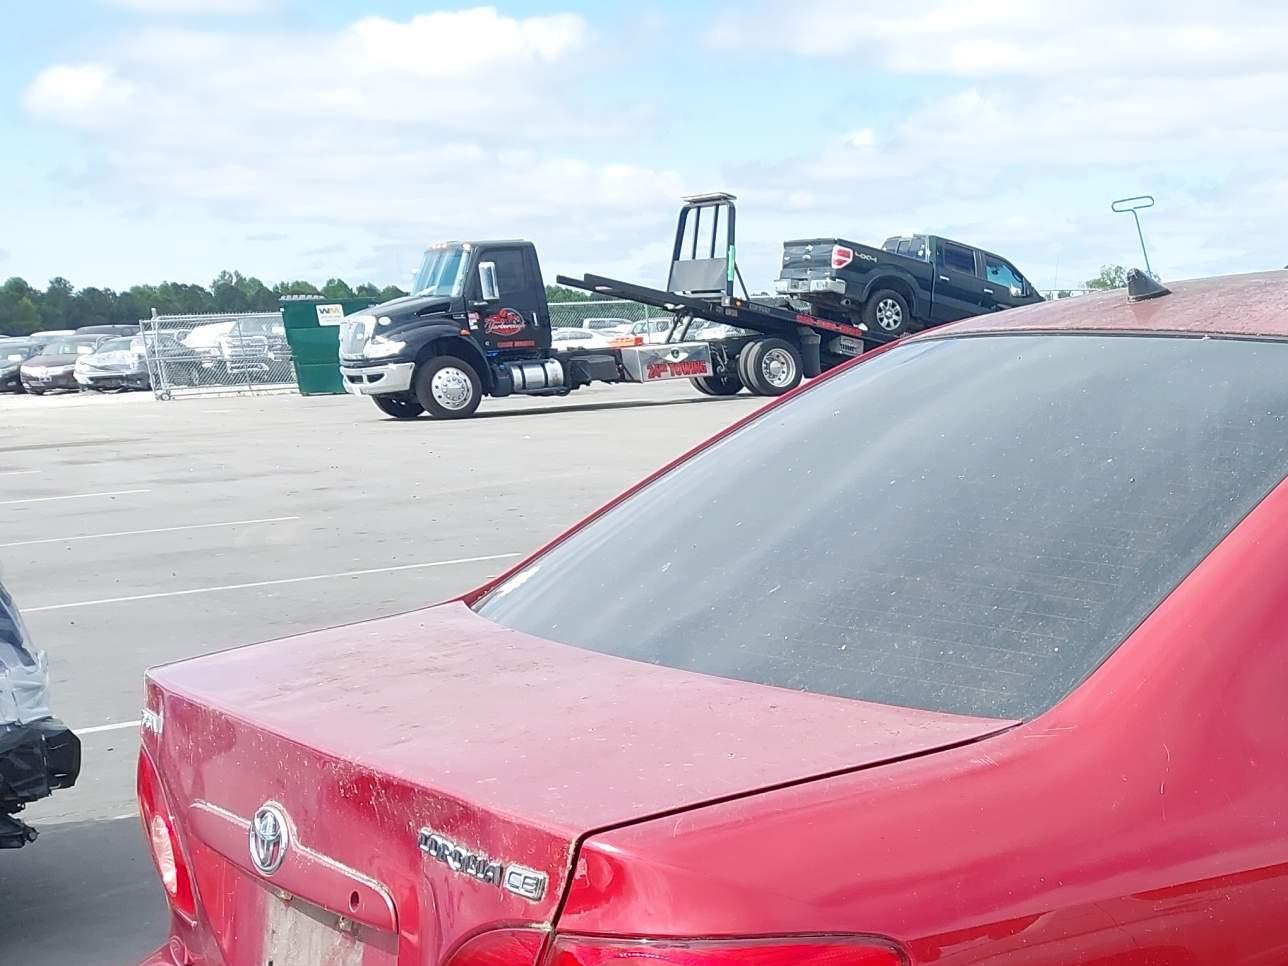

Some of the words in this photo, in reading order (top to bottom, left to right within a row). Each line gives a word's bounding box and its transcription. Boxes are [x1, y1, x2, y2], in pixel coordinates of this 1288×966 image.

[669, 359, 708, 377] TOWING
[419, 826, 503, 887] COROLLA
[506, 868, 541, 896] CE
